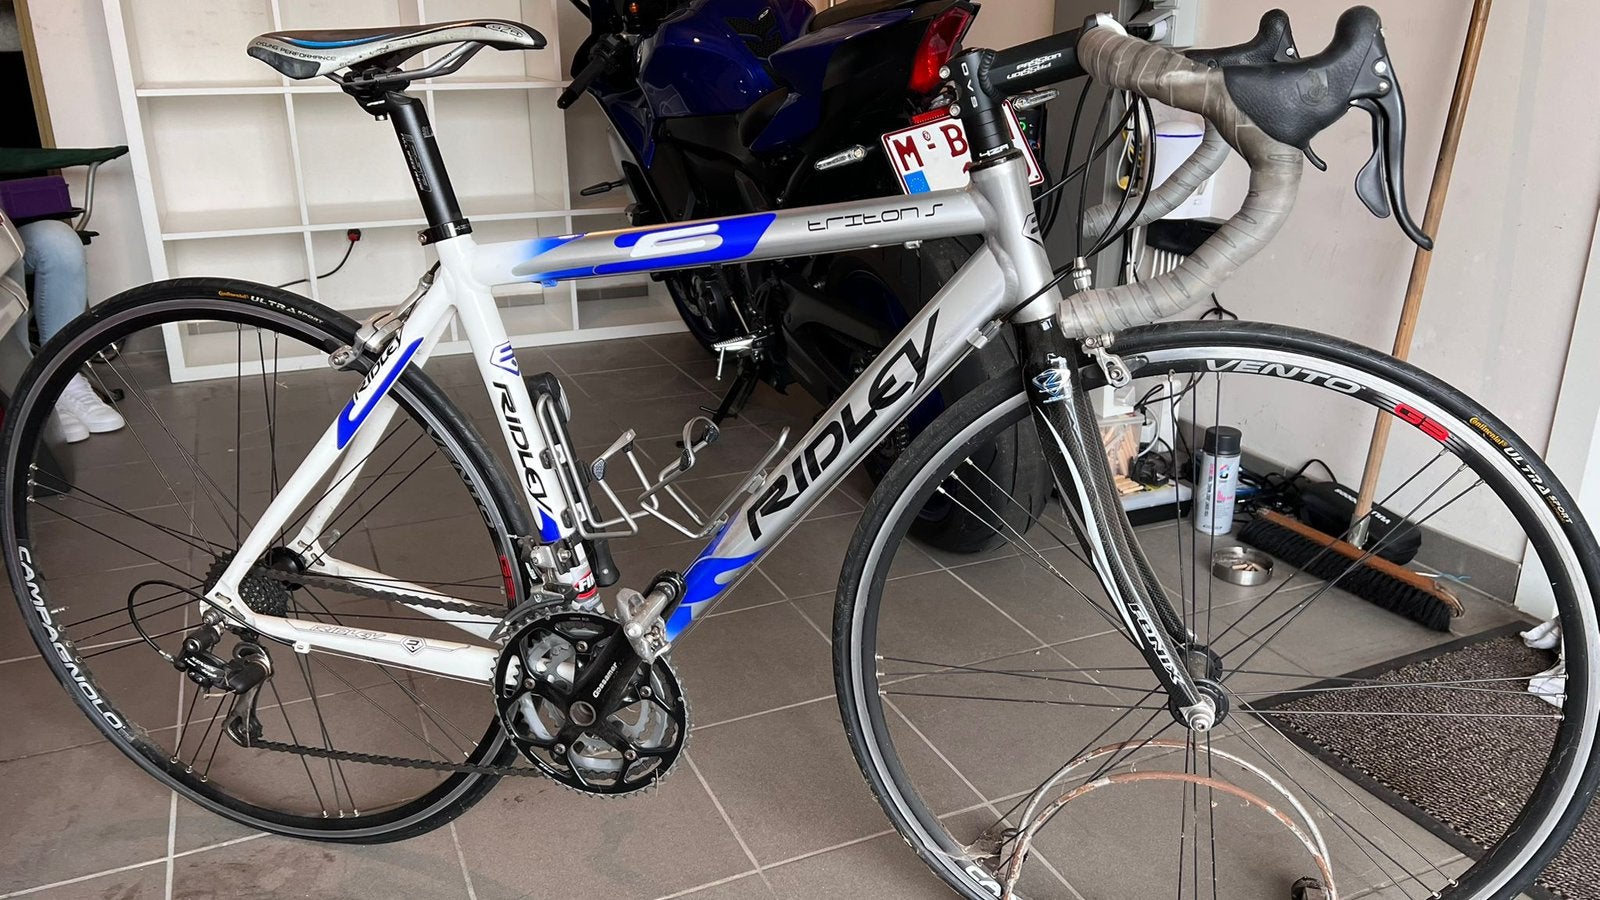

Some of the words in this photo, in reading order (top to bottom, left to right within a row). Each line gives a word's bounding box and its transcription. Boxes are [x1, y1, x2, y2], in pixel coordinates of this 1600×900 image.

[280, 48, 337, 61] PERFORMANCE
[250, 295, 298, 315] ULTRA
[297, 310, 324, 324] SPORT
[1206, 359, 1362, 394] VENTO
[493, 381, 554, 514] RIDLEY
[747, 308, 940, 541] RIDLEY
[1503, 447, 1551, 496] ULTRA
[1547, 495, 1574, 524] SPORT
[18, 545, 123, 730] CAMPAGNOLO
[592, 662, 618, 699] Gossamer
